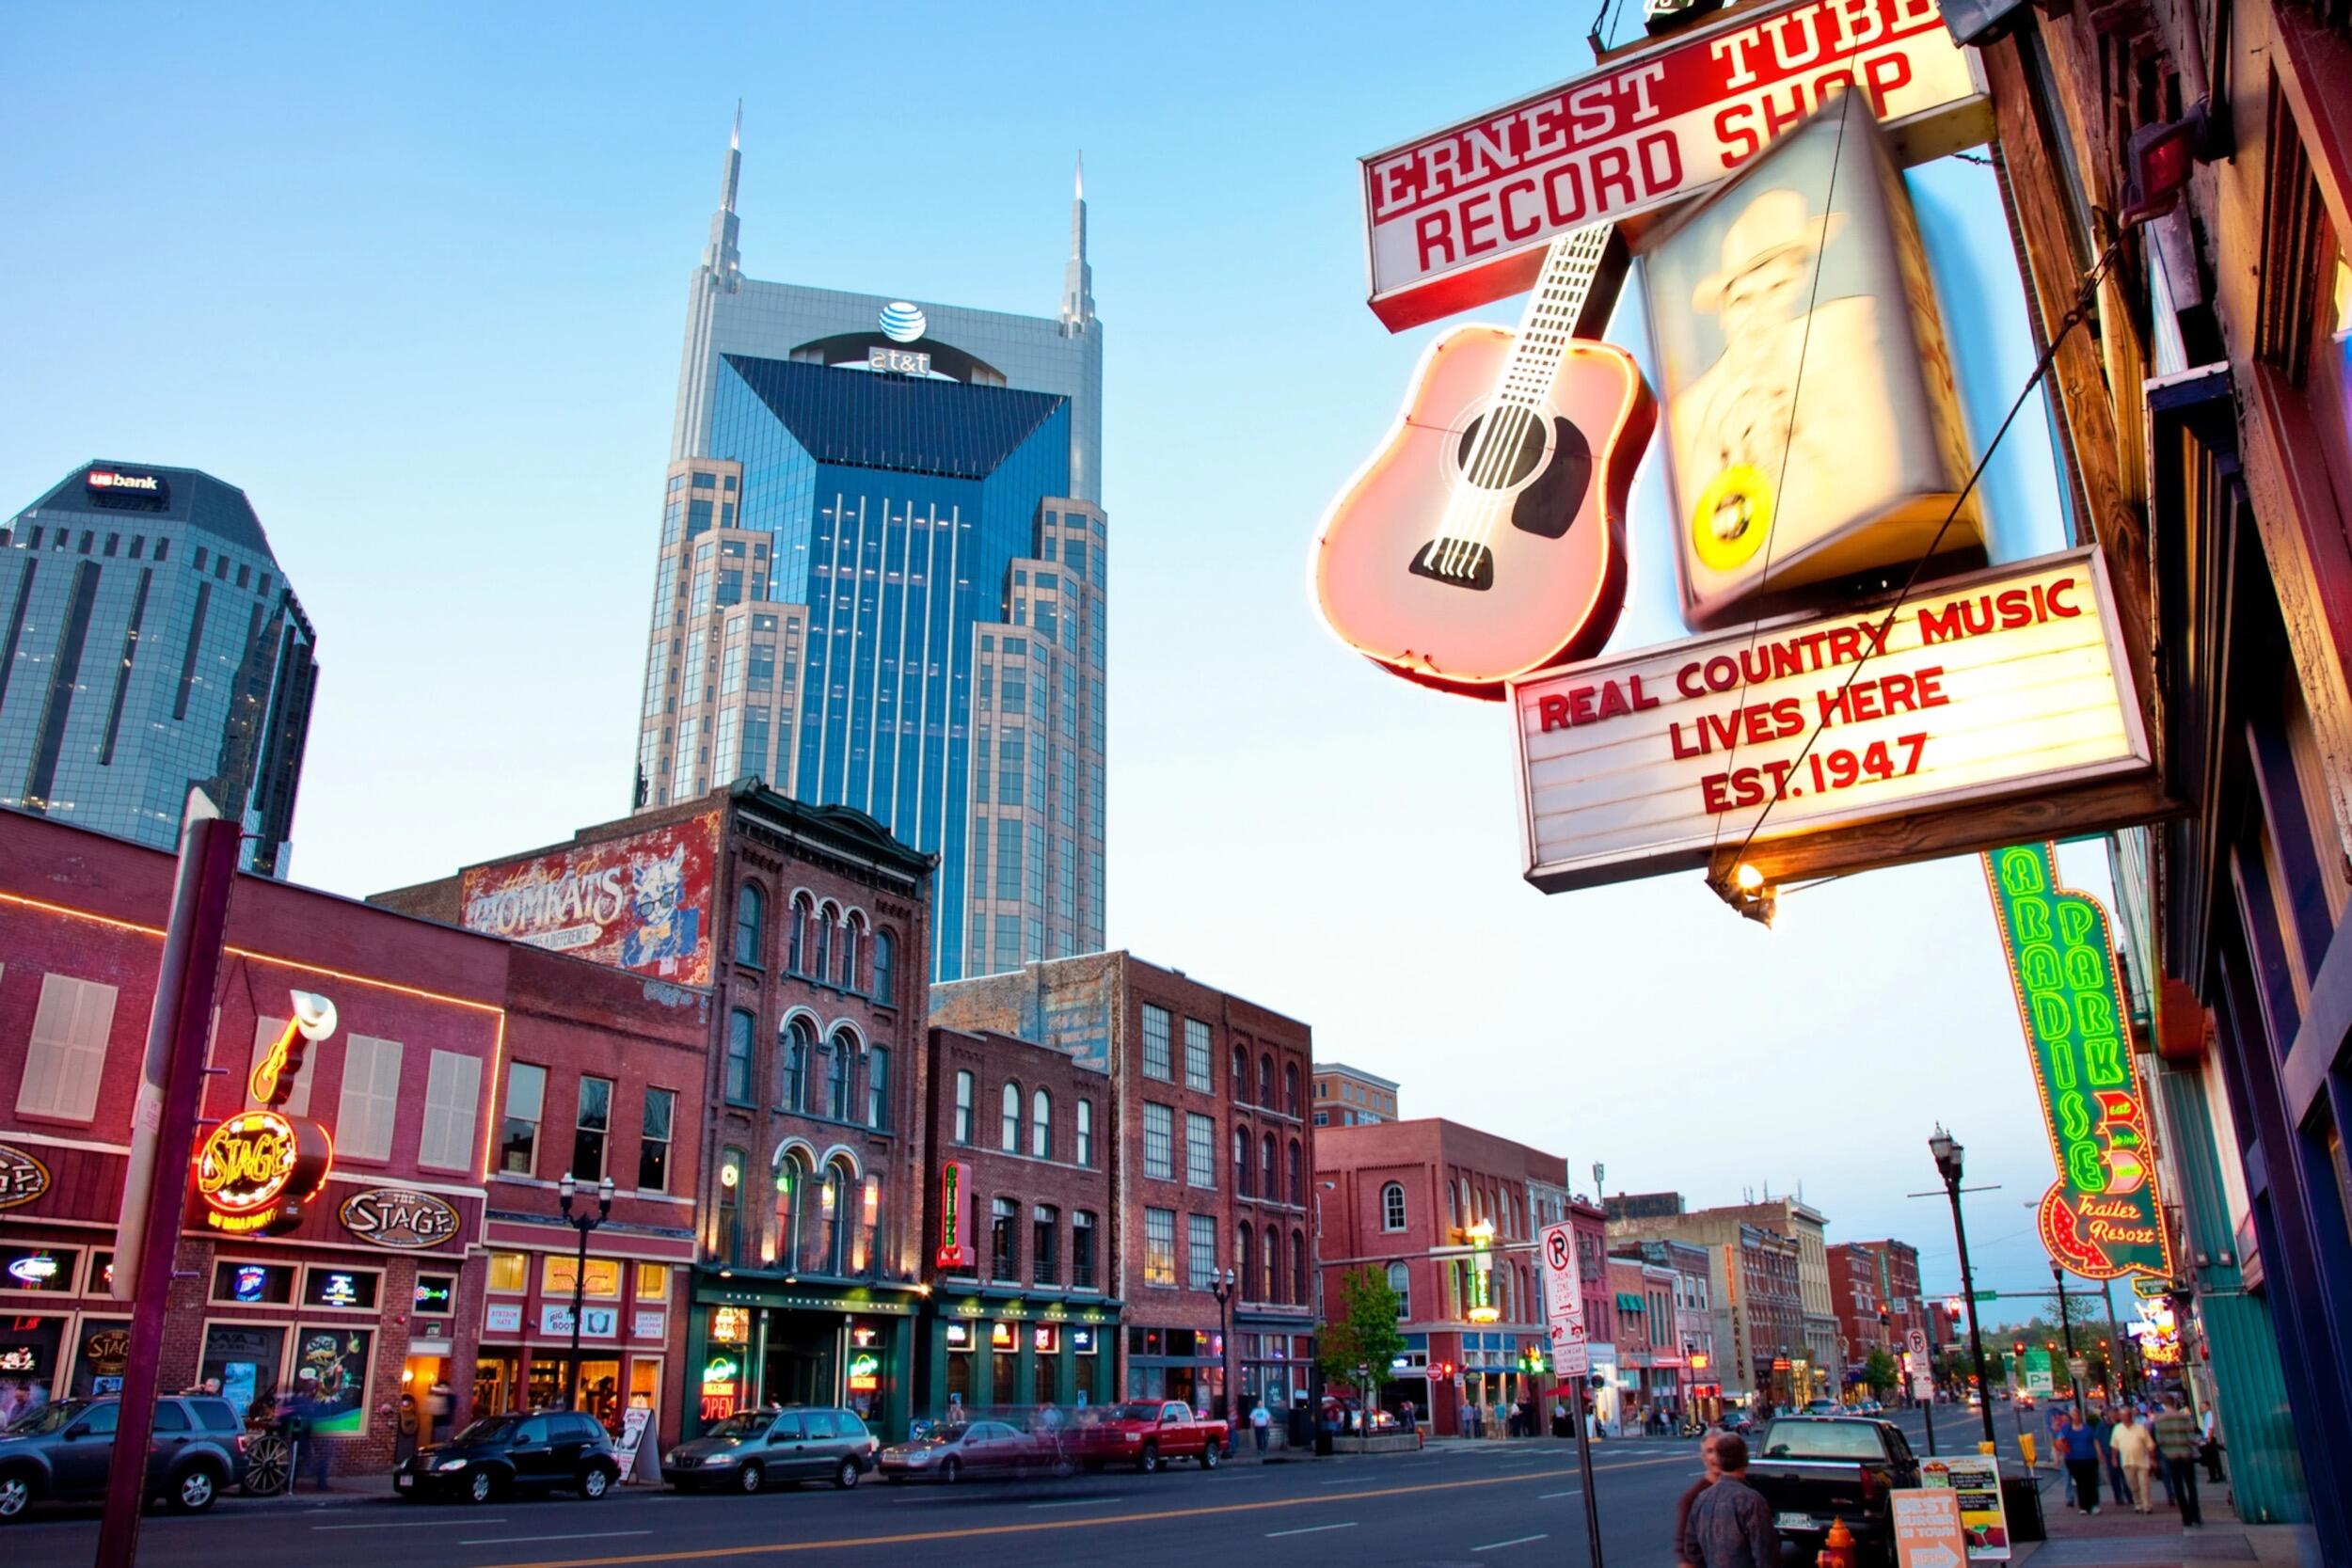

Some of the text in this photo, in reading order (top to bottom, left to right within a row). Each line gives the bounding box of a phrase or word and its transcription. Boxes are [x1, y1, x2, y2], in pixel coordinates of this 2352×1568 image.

[1375, 60, 1664, 217] ERNEST
[1415, 129, 1683, 273] RECORD
[871, 349, 929, 373] at&t
[1539, 578, 2082, 734] REAL COUNTRY MUSIC
[1669, 666, 1949, 760] LIVES HERE
[2058, 900, 2124, 1086] PARK
[2002, 846, 2106, 1193] ARADISE
[199, 1129, 290, 1194] STAGE
[347, 1194, 453, 1235] STAGE
[2077, 1195, 2141, 1219] Trailer
[2090, 1219, 2154, 1243] Resort
[87, 1334, 129, 1357] STAG
[552, 1322, 577, 1330] BOOT
[1732, 1306, 1745, 1380] PARKING
[701, 1397, 734, 1419] OPEN
[1895, 1496, 1953, 1515] BEST
[1917, 1526, 1957, 1537] TOWN
